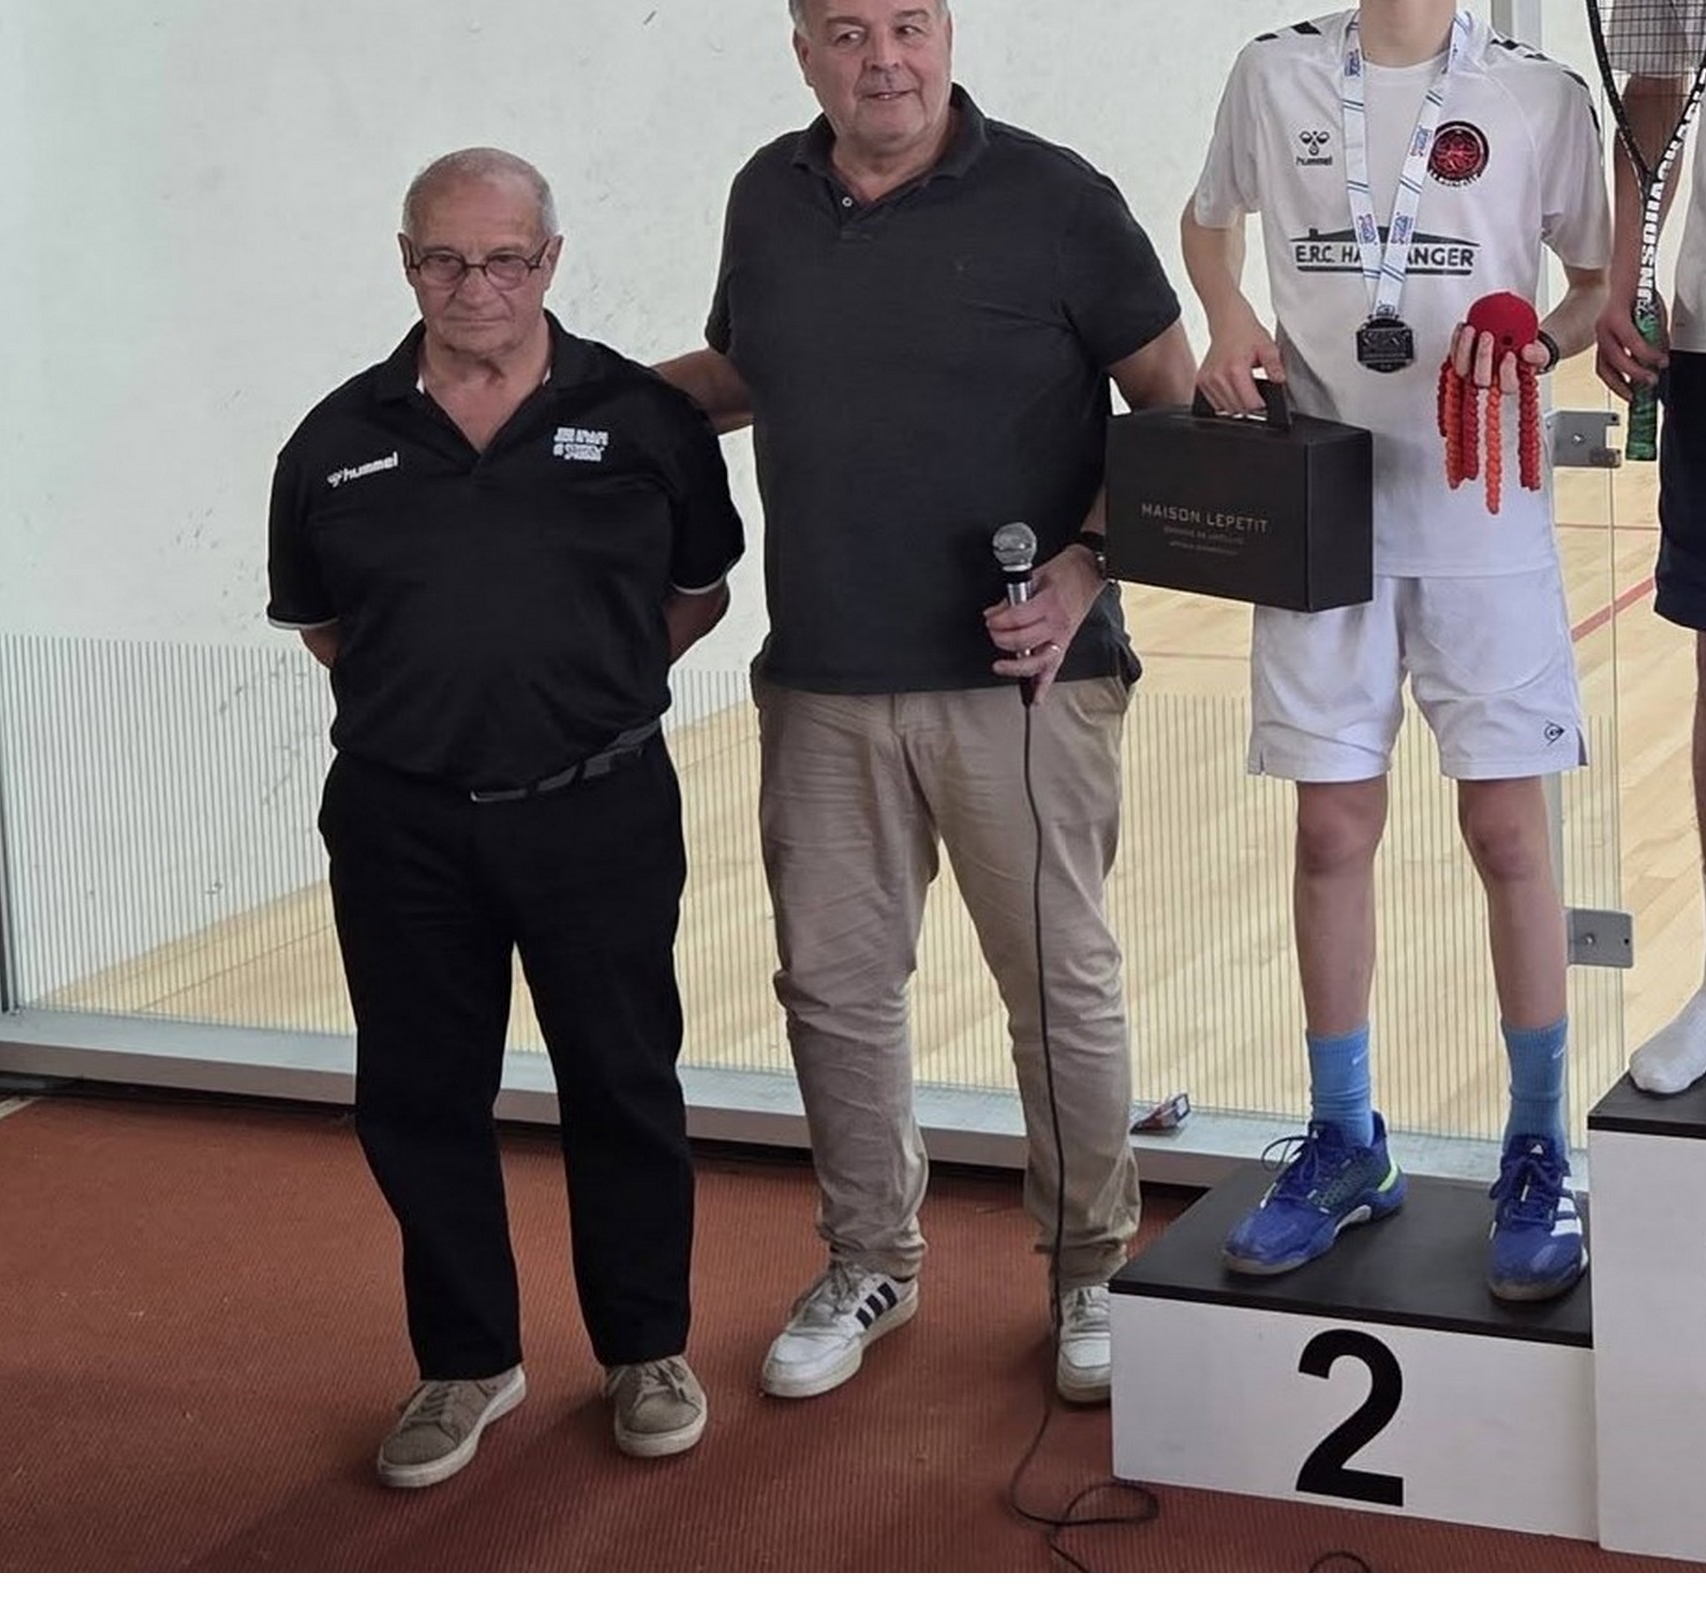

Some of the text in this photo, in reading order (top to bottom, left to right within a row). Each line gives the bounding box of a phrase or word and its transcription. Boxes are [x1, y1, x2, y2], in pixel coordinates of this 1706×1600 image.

[1296, 156, 1333, 167] hummel
[343, 450, 398, 482] hummel
[1141, 503, 1269, 533] MAISON LEPETIT
[1293, 1328, 1405, 1508] 2
